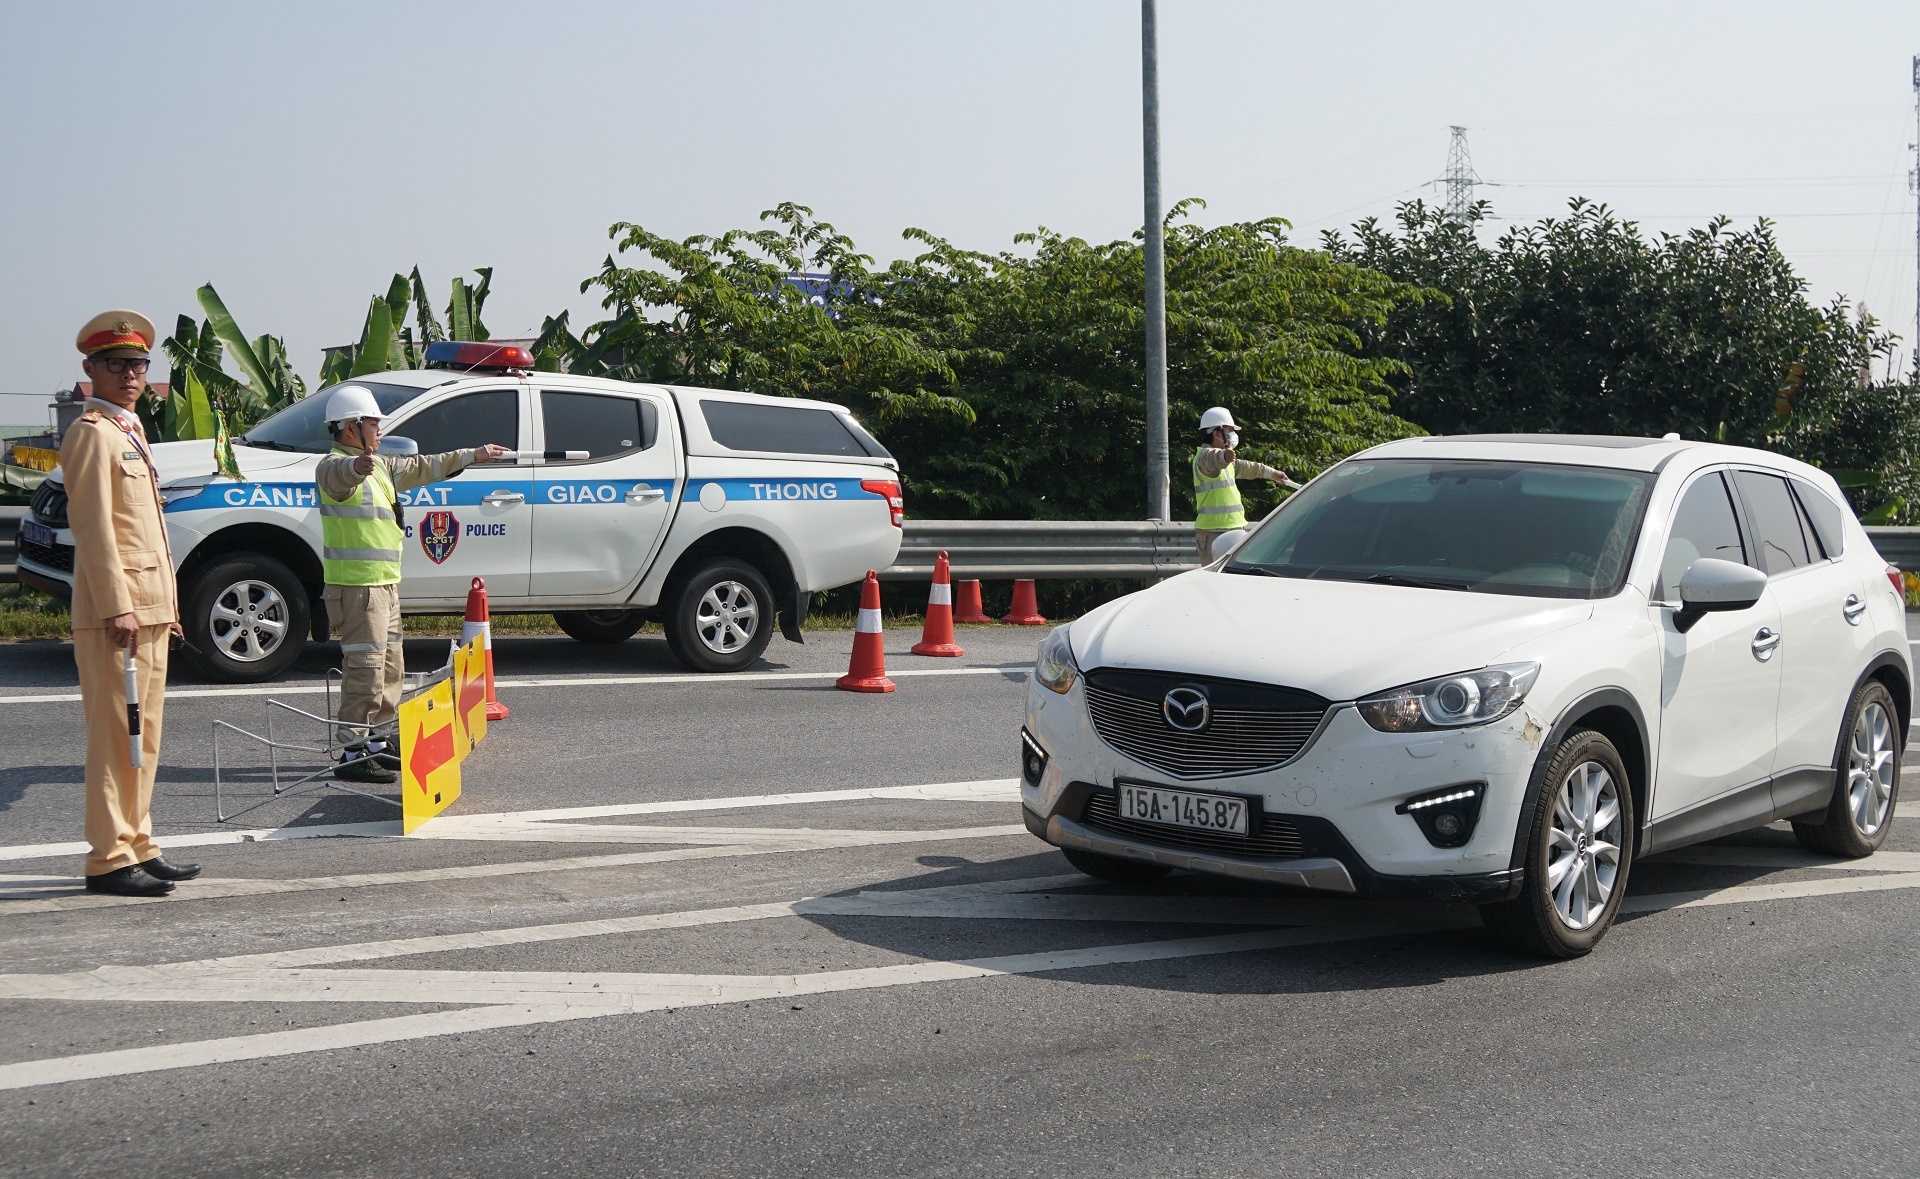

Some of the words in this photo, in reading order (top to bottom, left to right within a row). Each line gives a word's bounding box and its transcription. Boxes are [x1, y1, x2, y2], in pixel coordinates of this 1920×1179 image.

[223, 484, 316, 506] CẢNH
[547, 485, 617, 503] GIAO
[466, 524, 506, 537] POLICE
[1126, 788, 1242, 830] 15A-145.87
